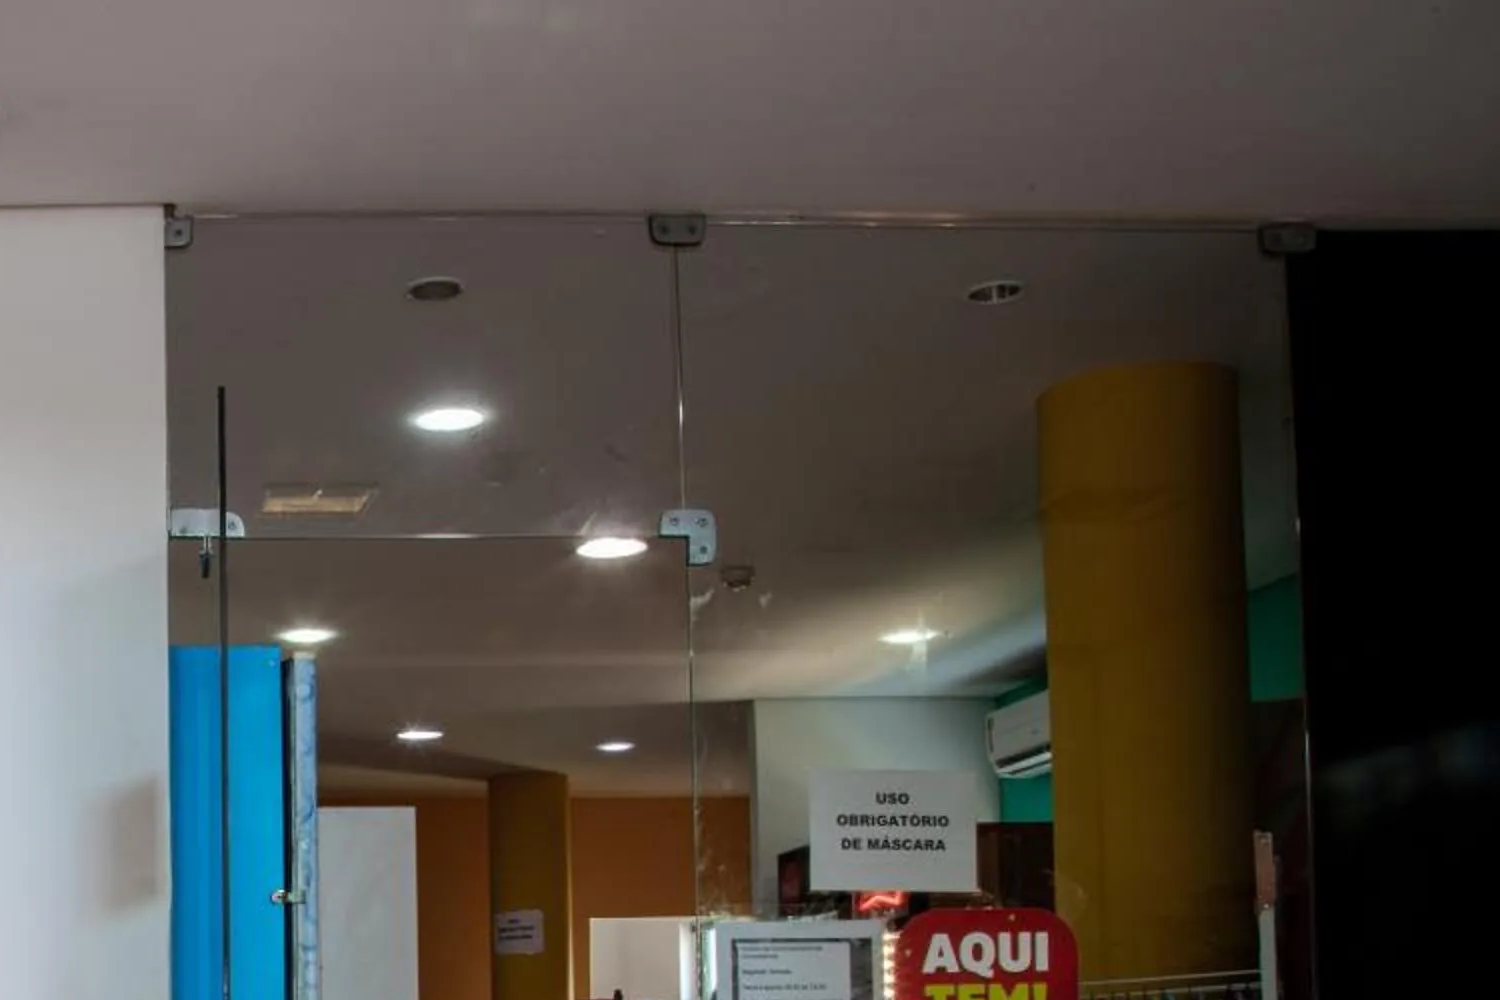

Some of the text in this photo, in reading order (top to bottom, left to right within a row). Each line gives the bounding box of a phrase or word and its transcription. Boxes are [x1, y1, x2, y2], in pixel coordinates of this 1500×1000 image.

[875, 791, 910, 805] USO
[836, 811, 950, 827] OBRIGATÓRIO
[841, 834, 947, 851] DE MÁSCARA
[923, 931, 1049, 978] AQUI
